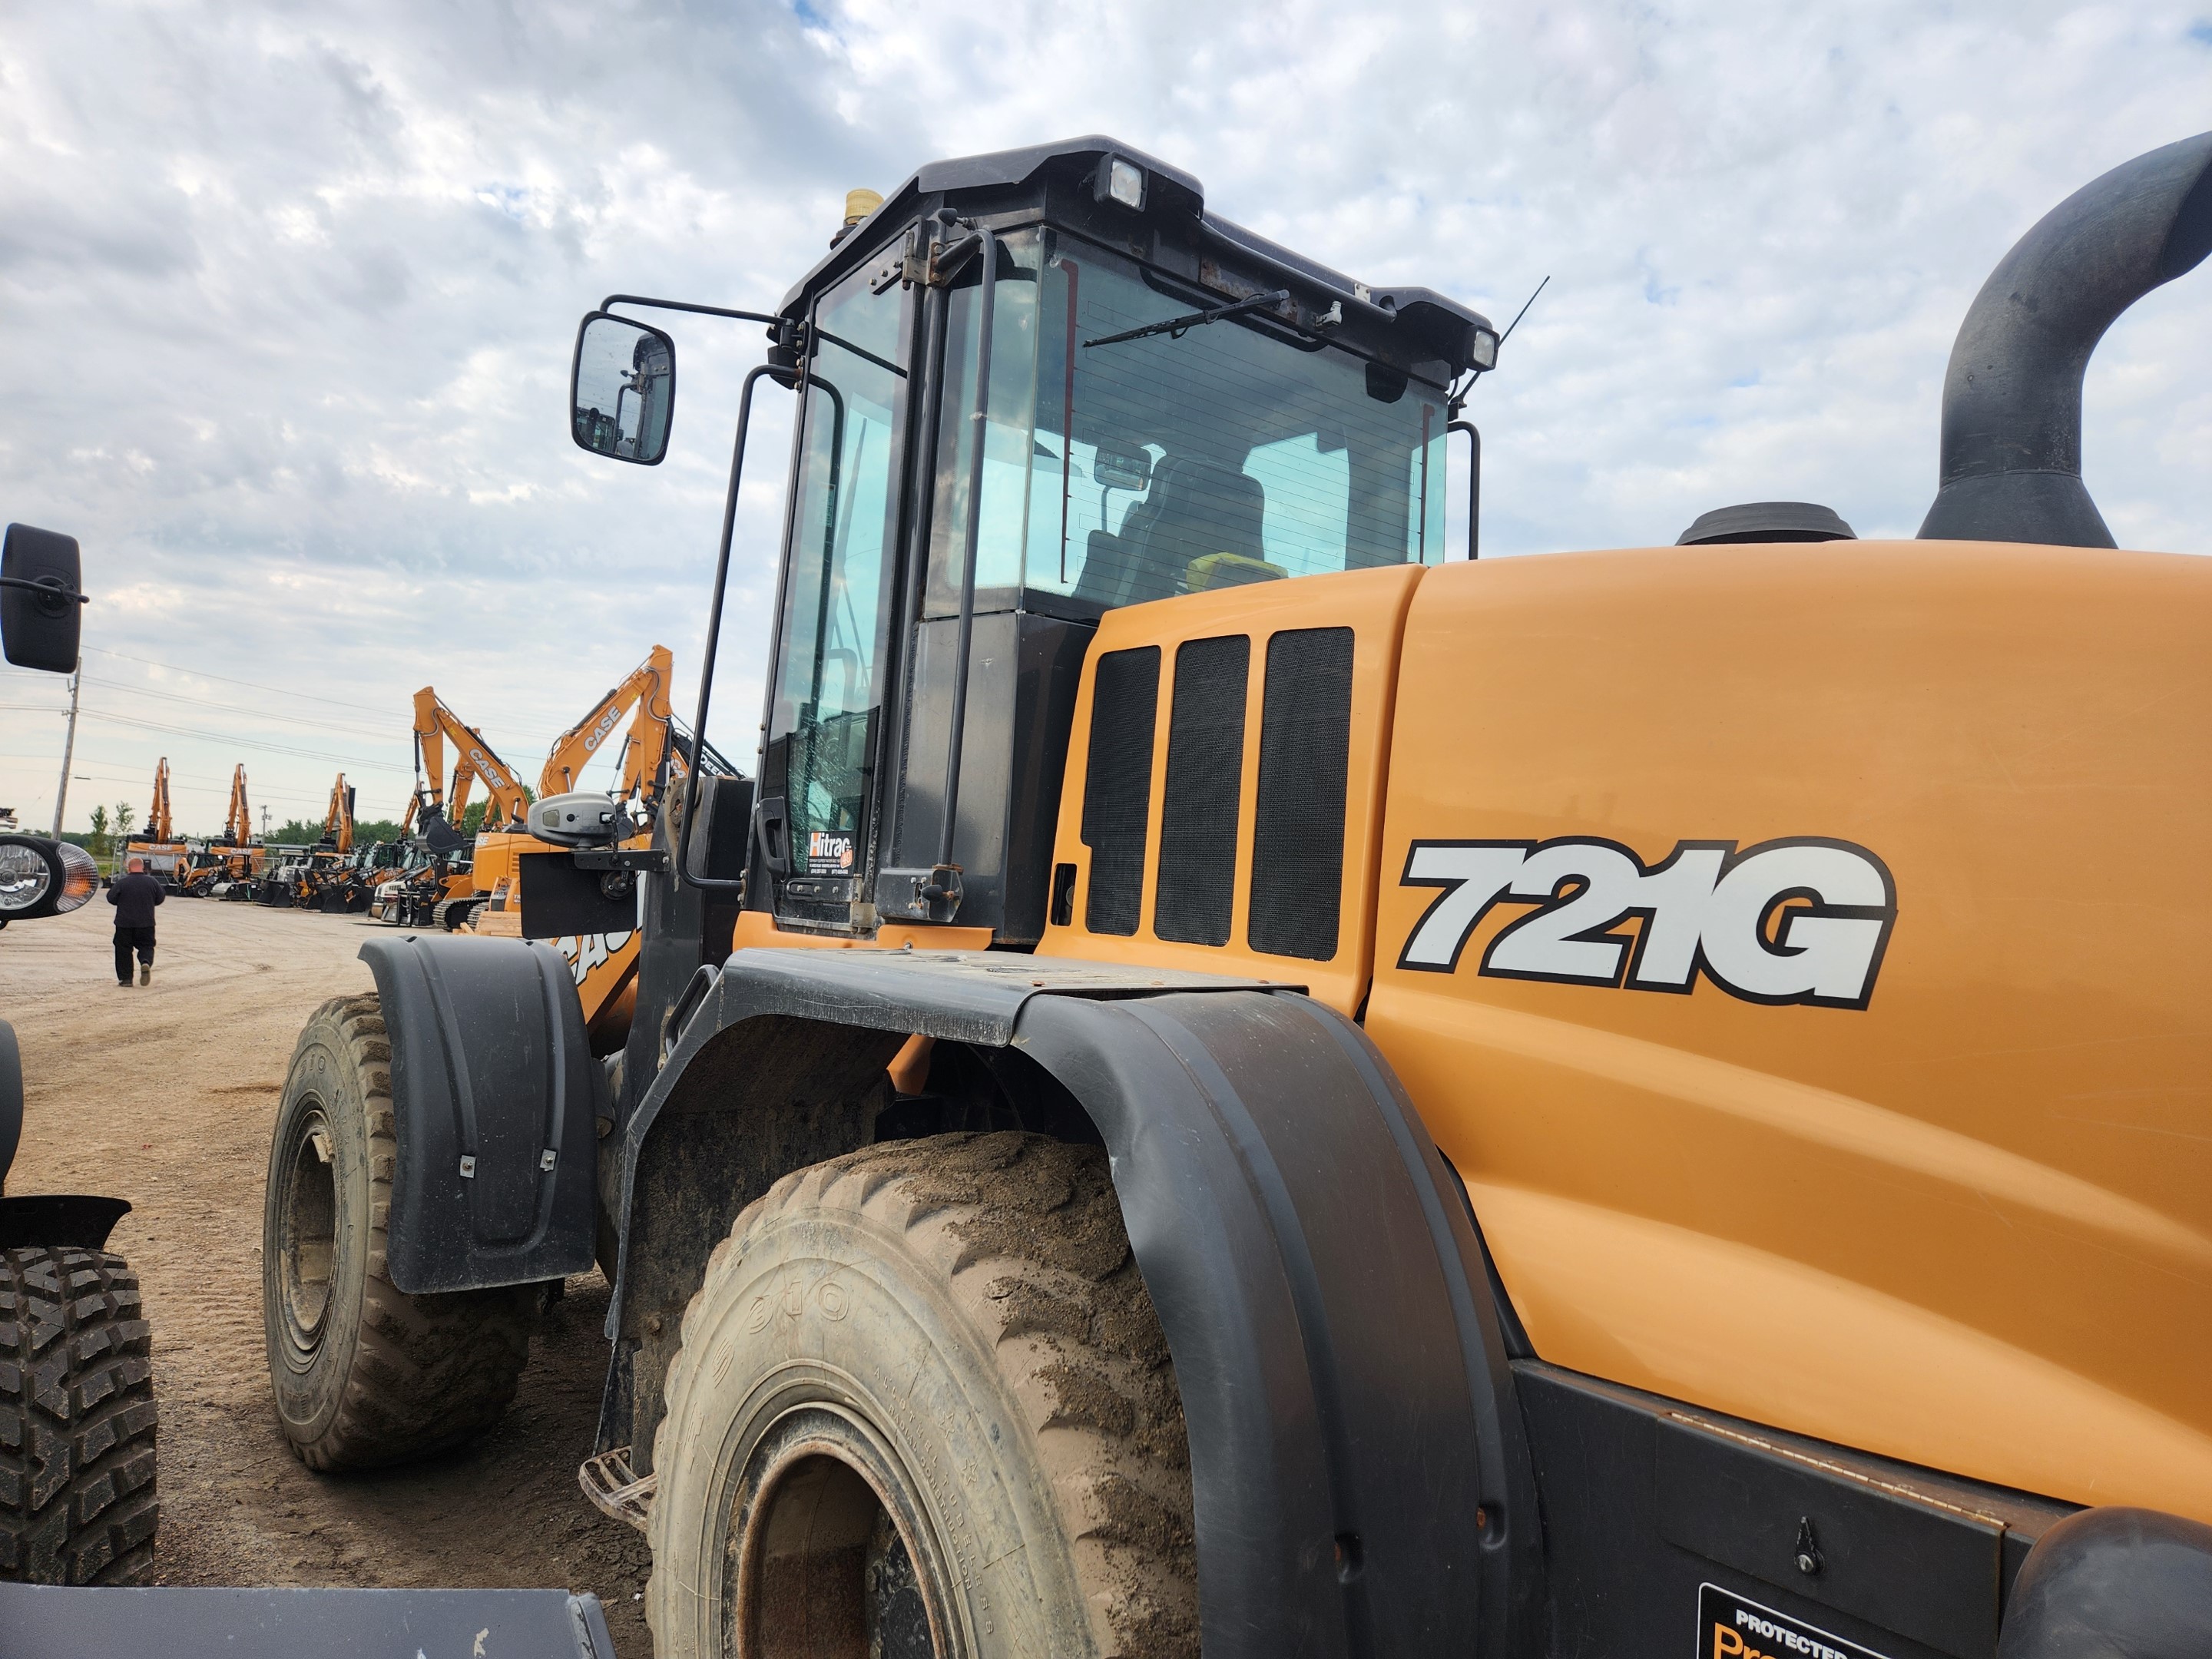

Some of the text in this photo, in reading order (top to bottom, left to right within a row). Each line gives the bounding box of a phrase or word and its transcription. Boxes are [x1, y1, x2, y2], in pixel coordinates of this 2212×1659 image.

[584, 705, 621, 751] CASE
[469, 748, 505, 789] CASE
[810, 832, 850, 857] Hitrac
[1396, 836, 1898, 1011] 721G
